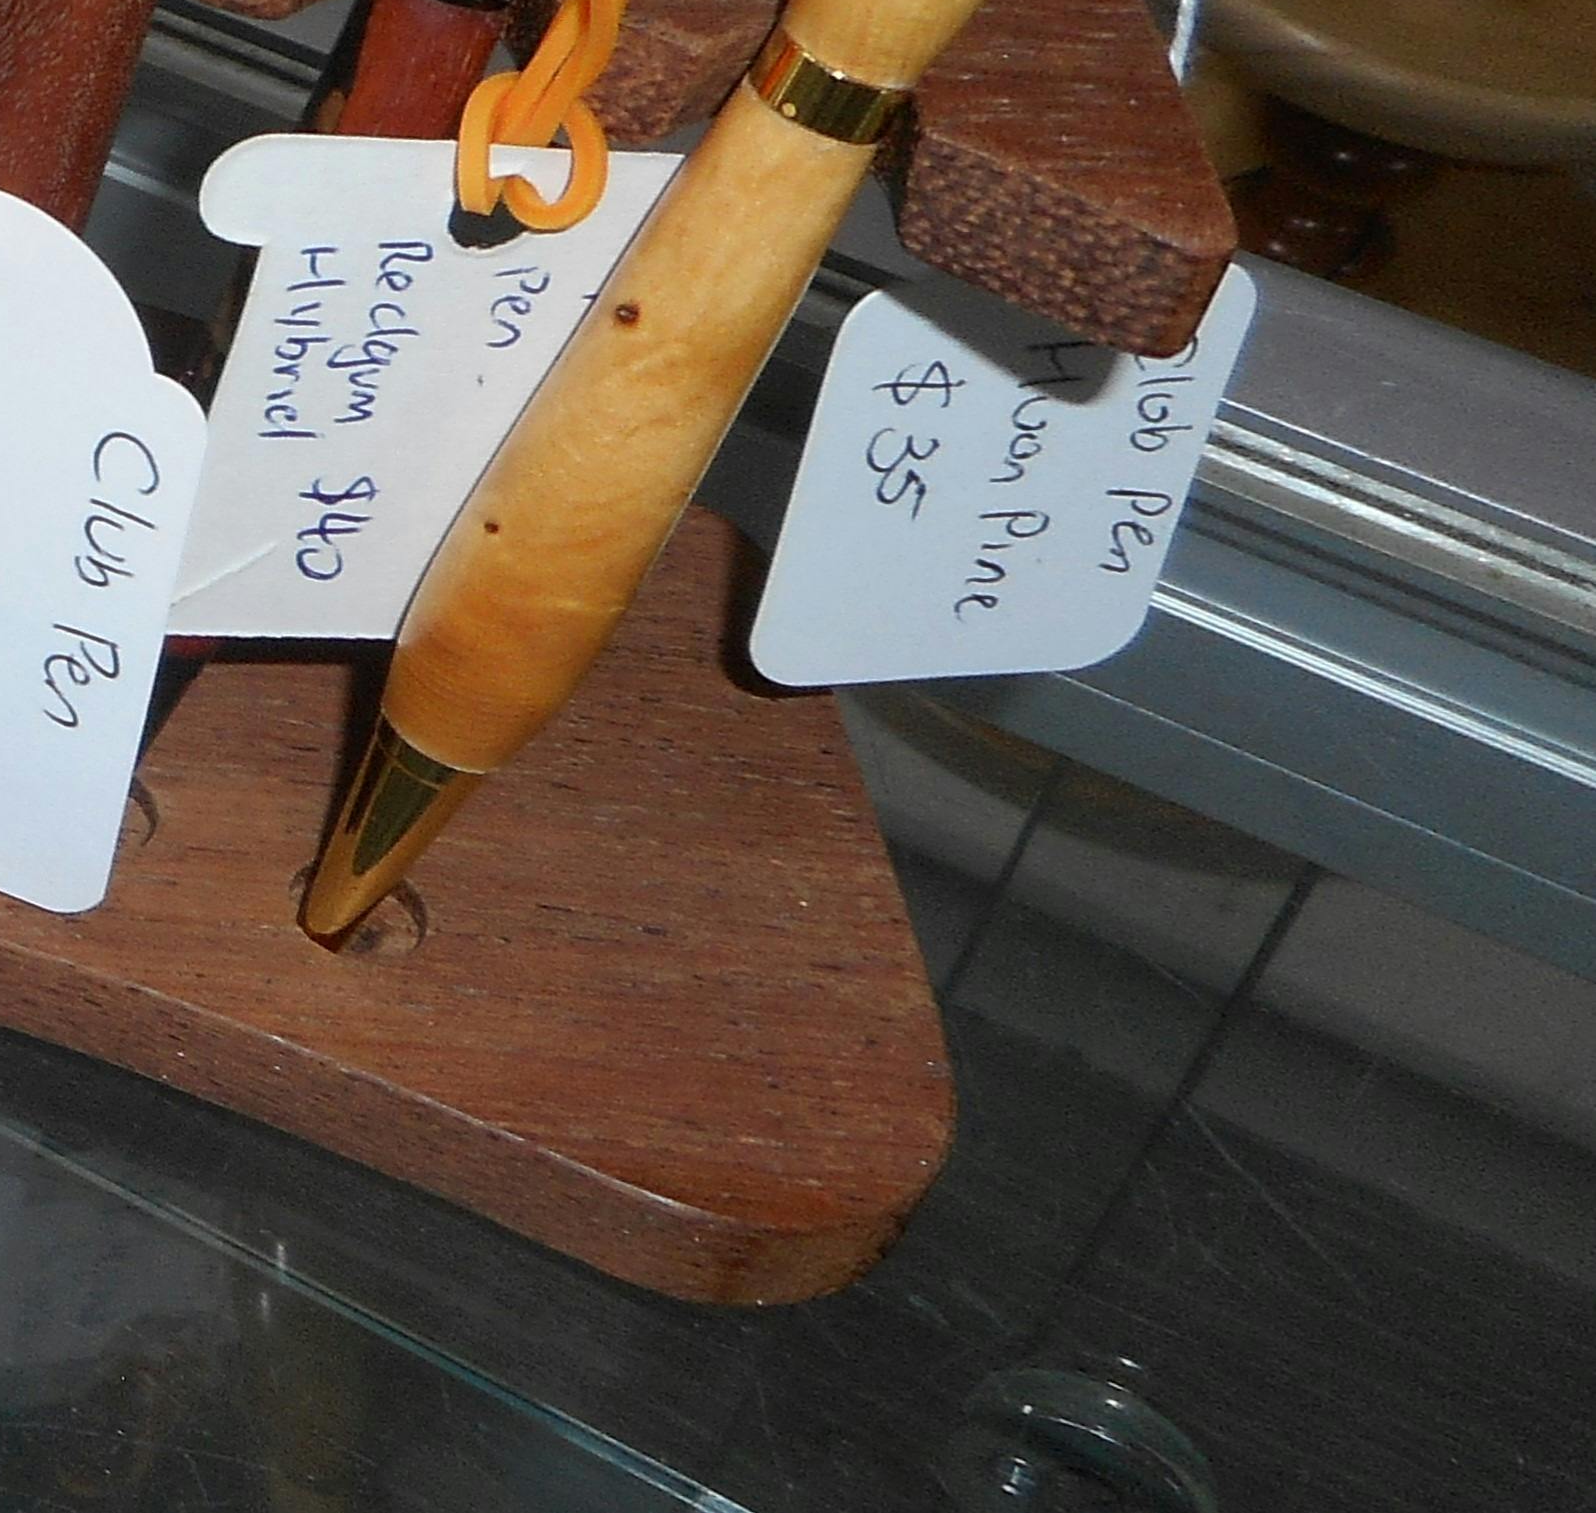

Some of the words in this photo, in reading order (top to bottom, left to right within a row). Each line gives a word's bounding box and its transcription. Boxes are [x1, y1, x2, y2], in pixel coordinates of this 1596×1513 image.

[485, 265, 552, 349] Pen
[55, 429, 160, 591] Club
[295, 474, 380, 582] $40
[1097, 488, 1174, 574] Pen
[953, 508, 1051, 623] Pine
[41, 621, 121, 729] Pen
